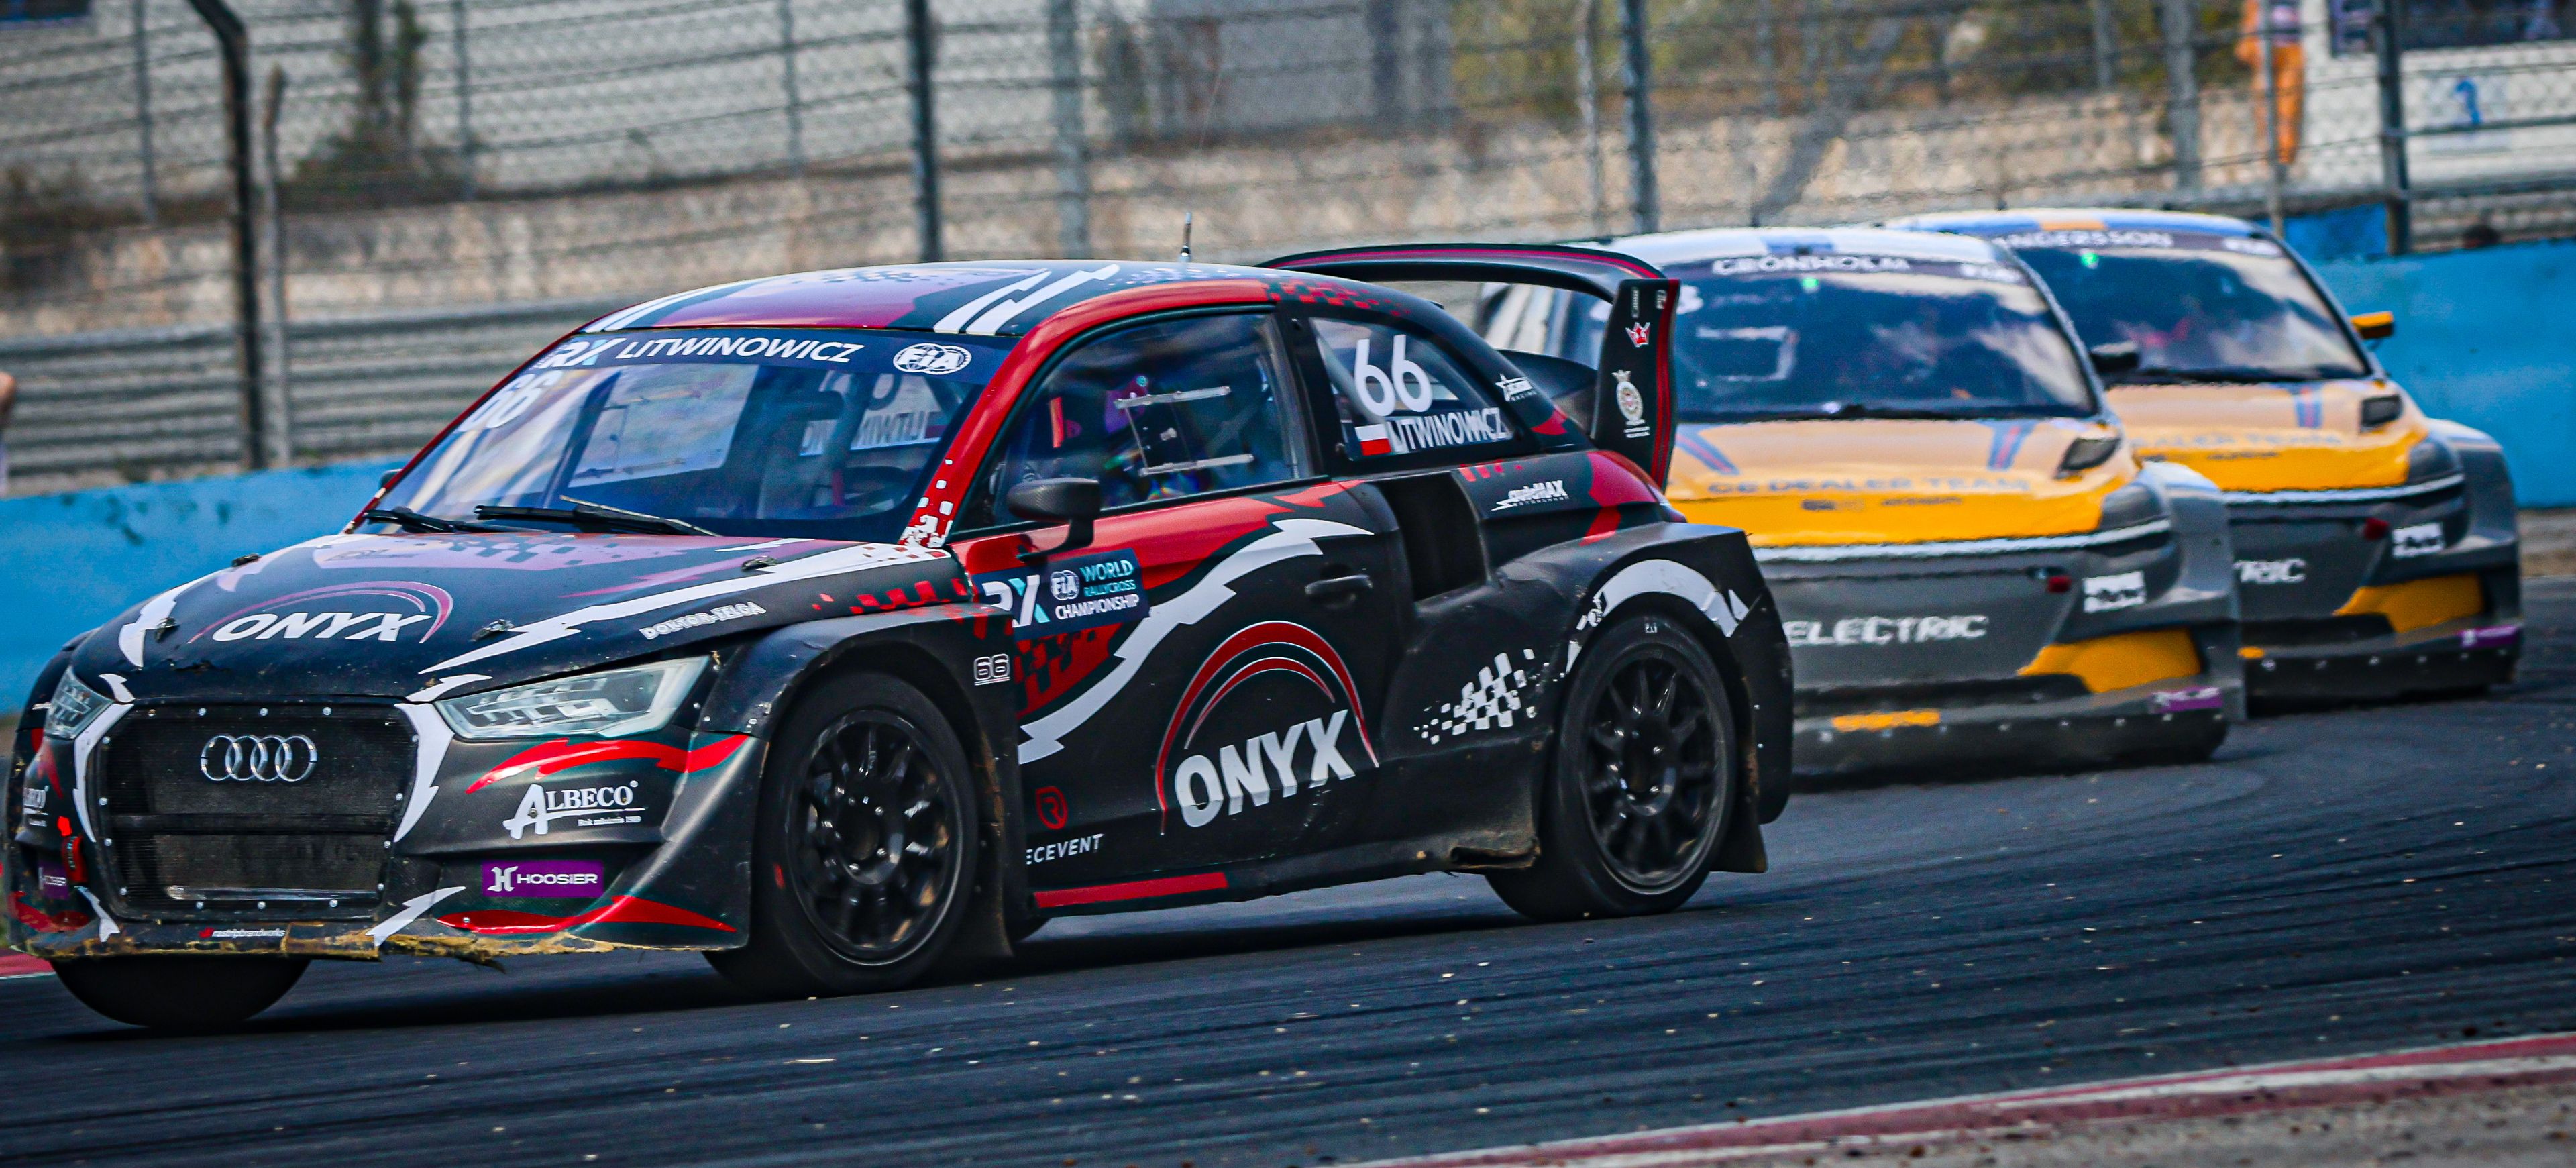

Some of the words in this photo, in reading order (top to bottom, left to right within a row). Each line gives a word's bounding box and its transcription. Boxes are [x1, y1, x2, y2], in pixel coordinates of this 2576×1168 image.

[615, 337, 865, 363] LITWINOWICZ
[1354, 334, 1433, 417] 66
[1387, 407, 1507, 454] LITWINOWICZ
[1079, 560, 1134, 582] WORLD
[1083, 579, 1136, 597] RALLYCROSS
[1055, 594, 1140, 619] CHAMPIONSHIP
[213, 613, 433, 641] ONYX
[974, 653, 1010, 682] 66
[1175, 709, 1356, 827] ONYX
[517, 873, 598, 884] HOOSIER
